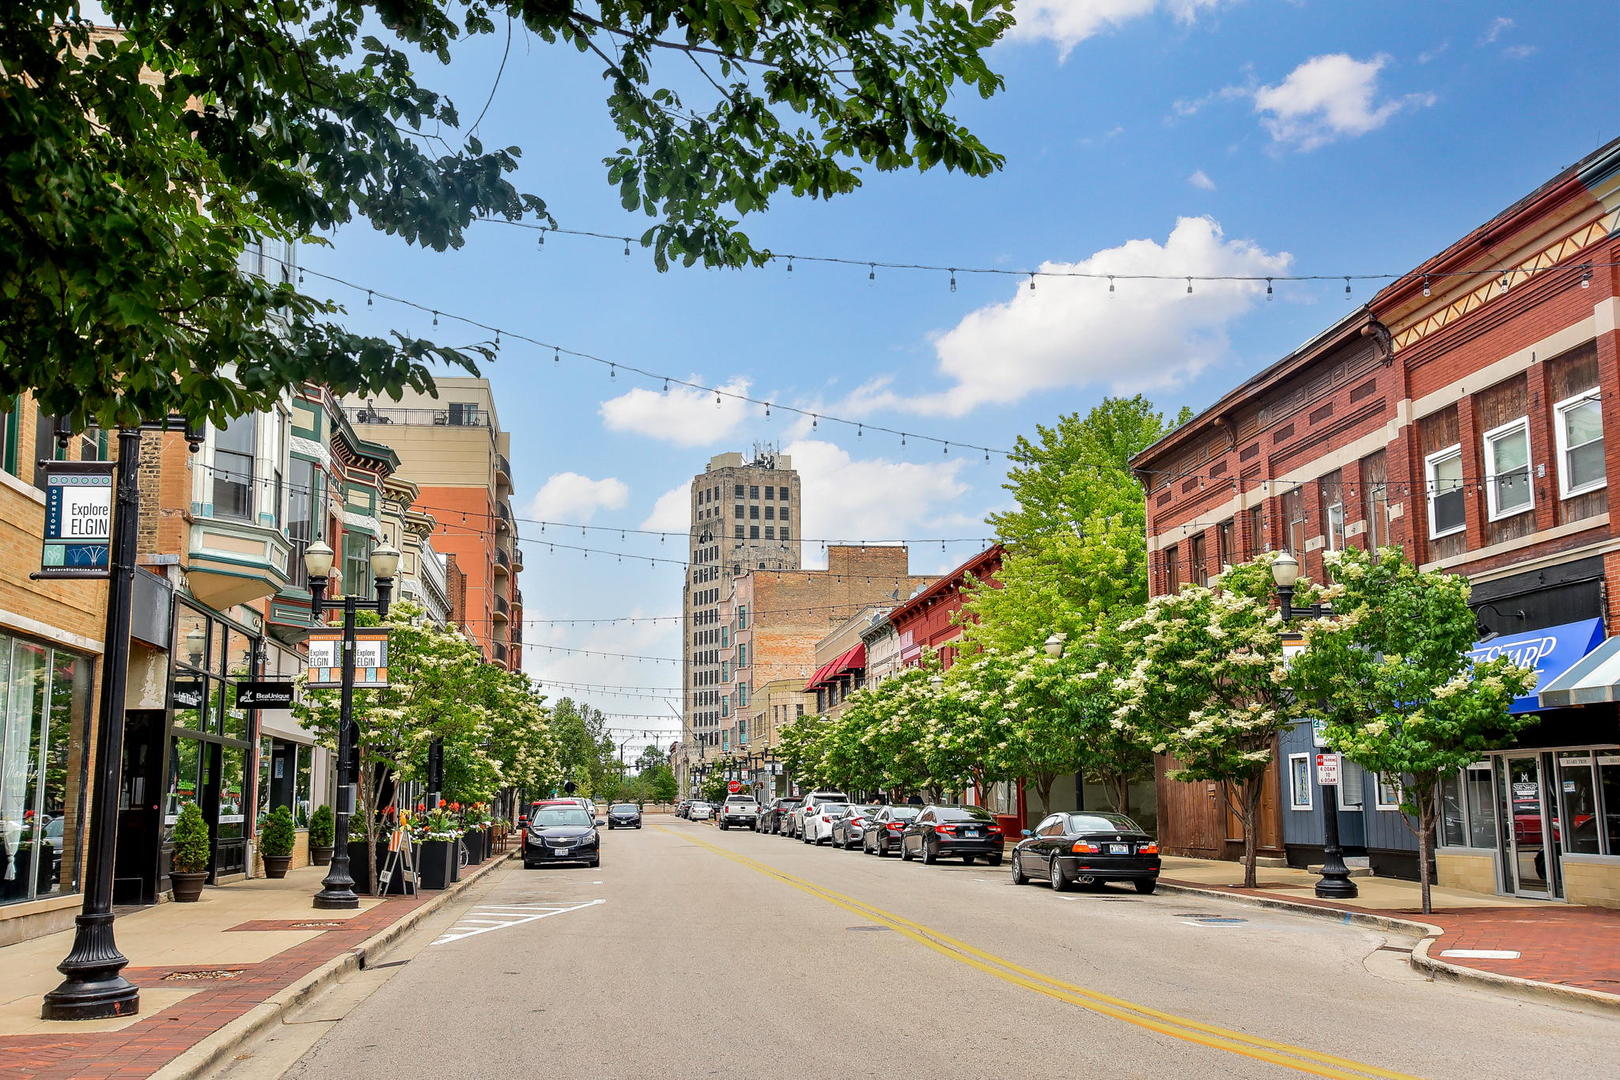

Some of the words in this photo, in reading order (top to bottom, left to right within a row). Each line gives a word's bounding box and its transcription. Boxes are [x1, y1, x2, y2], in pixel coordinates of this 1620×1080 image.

[49, 489, 57, 535] DOWNTOWN
[71, 502, 109, 518] Explore
[71, 518, 108, 535] ELGIN
[310, 649, 329, 657] Explore
[356, 649, 376, 657] Explore
[309, 657, 329, 667] ELGIN
[356, 657, 376, 667] ELGIN
[255, 692, 290, 700] BeaUnique
